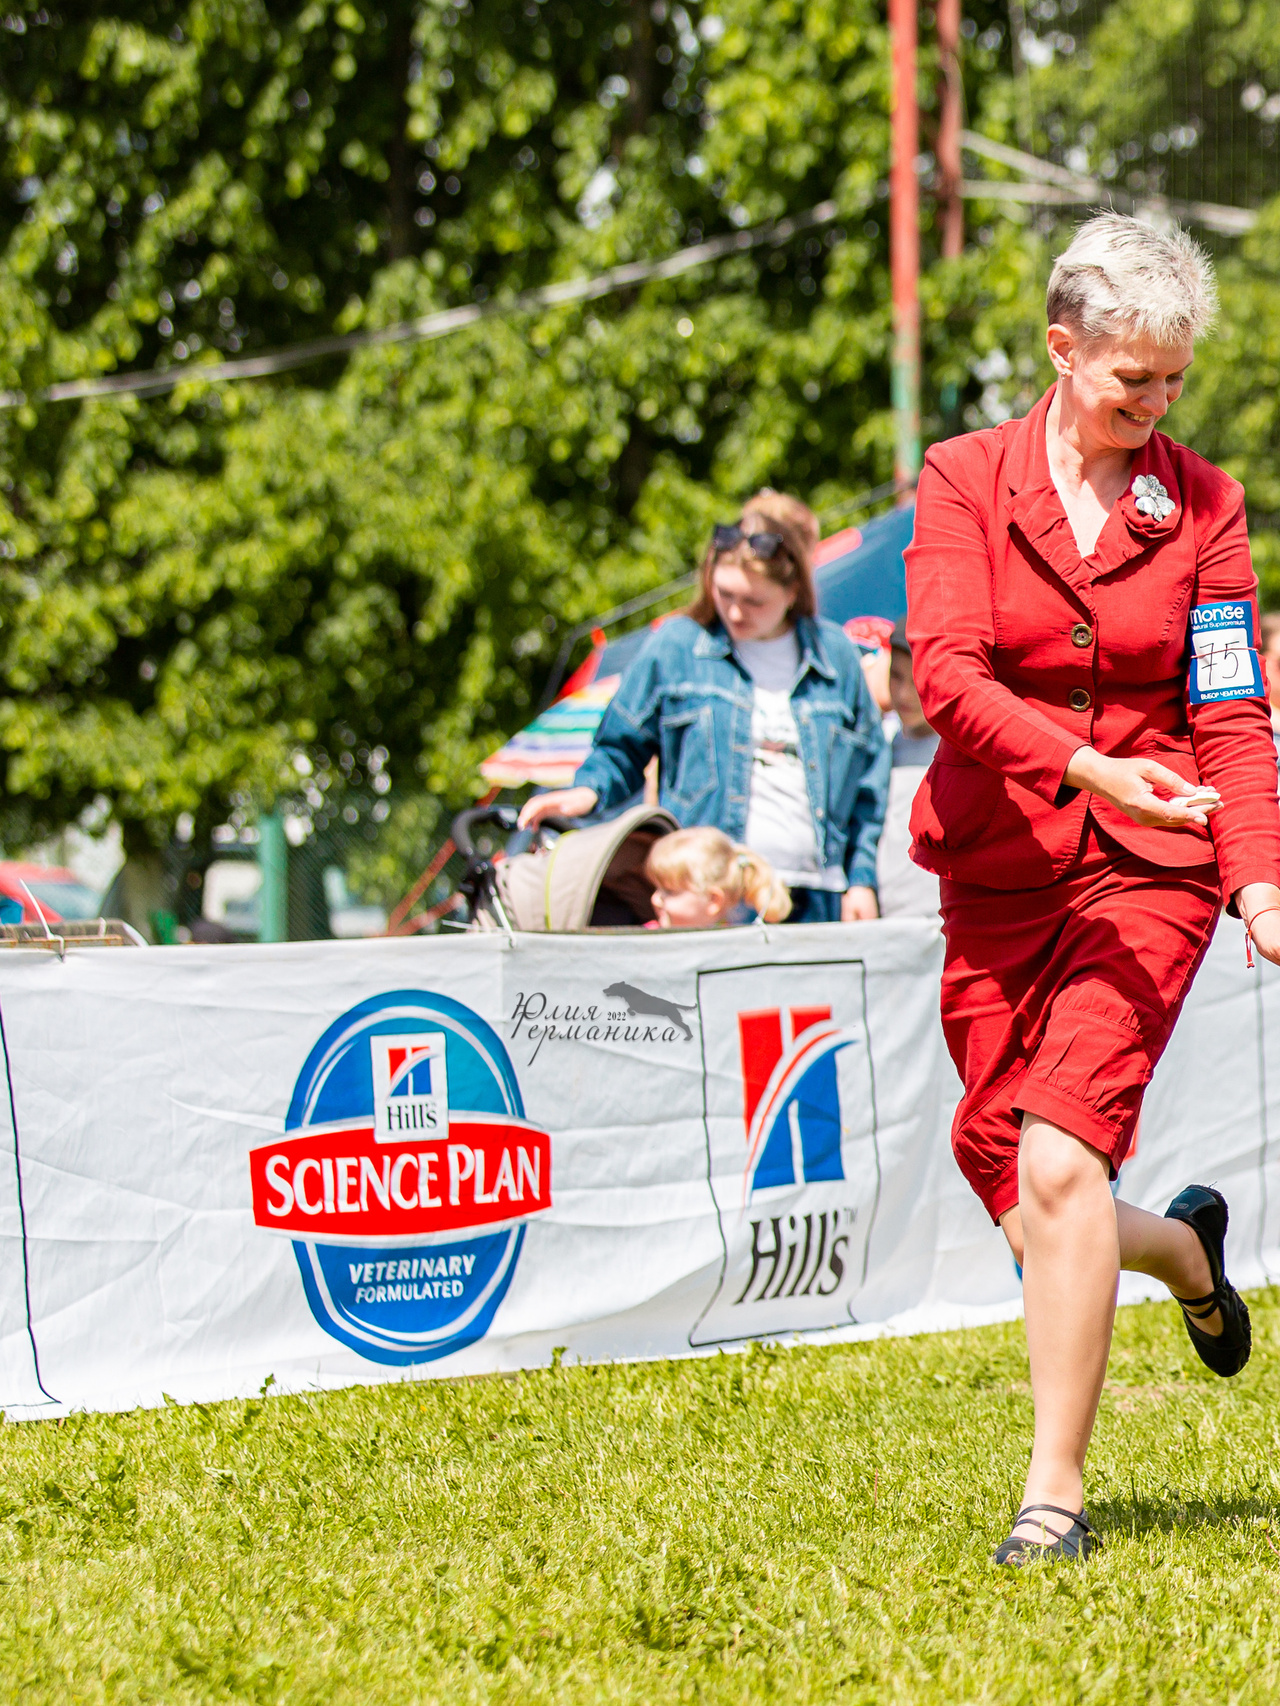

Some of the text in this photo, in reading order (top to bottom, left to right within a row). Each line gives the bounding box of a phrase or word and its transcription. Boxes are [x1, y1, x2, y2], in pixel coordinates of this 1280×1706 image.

[1199, 641, 1240, 686] 75
[1200, 692, 1219, 701] ВЫБОР
[386, 1102, 438, 1132] Hill's
[265, 1144, 542, 1217] SCIENCE PLAN
[348, 1253, 477, 1285] VETERINARY
[733, 1209, 850, 1306] Hill's
[354, 1279, 465, 1305] FORMULATED
